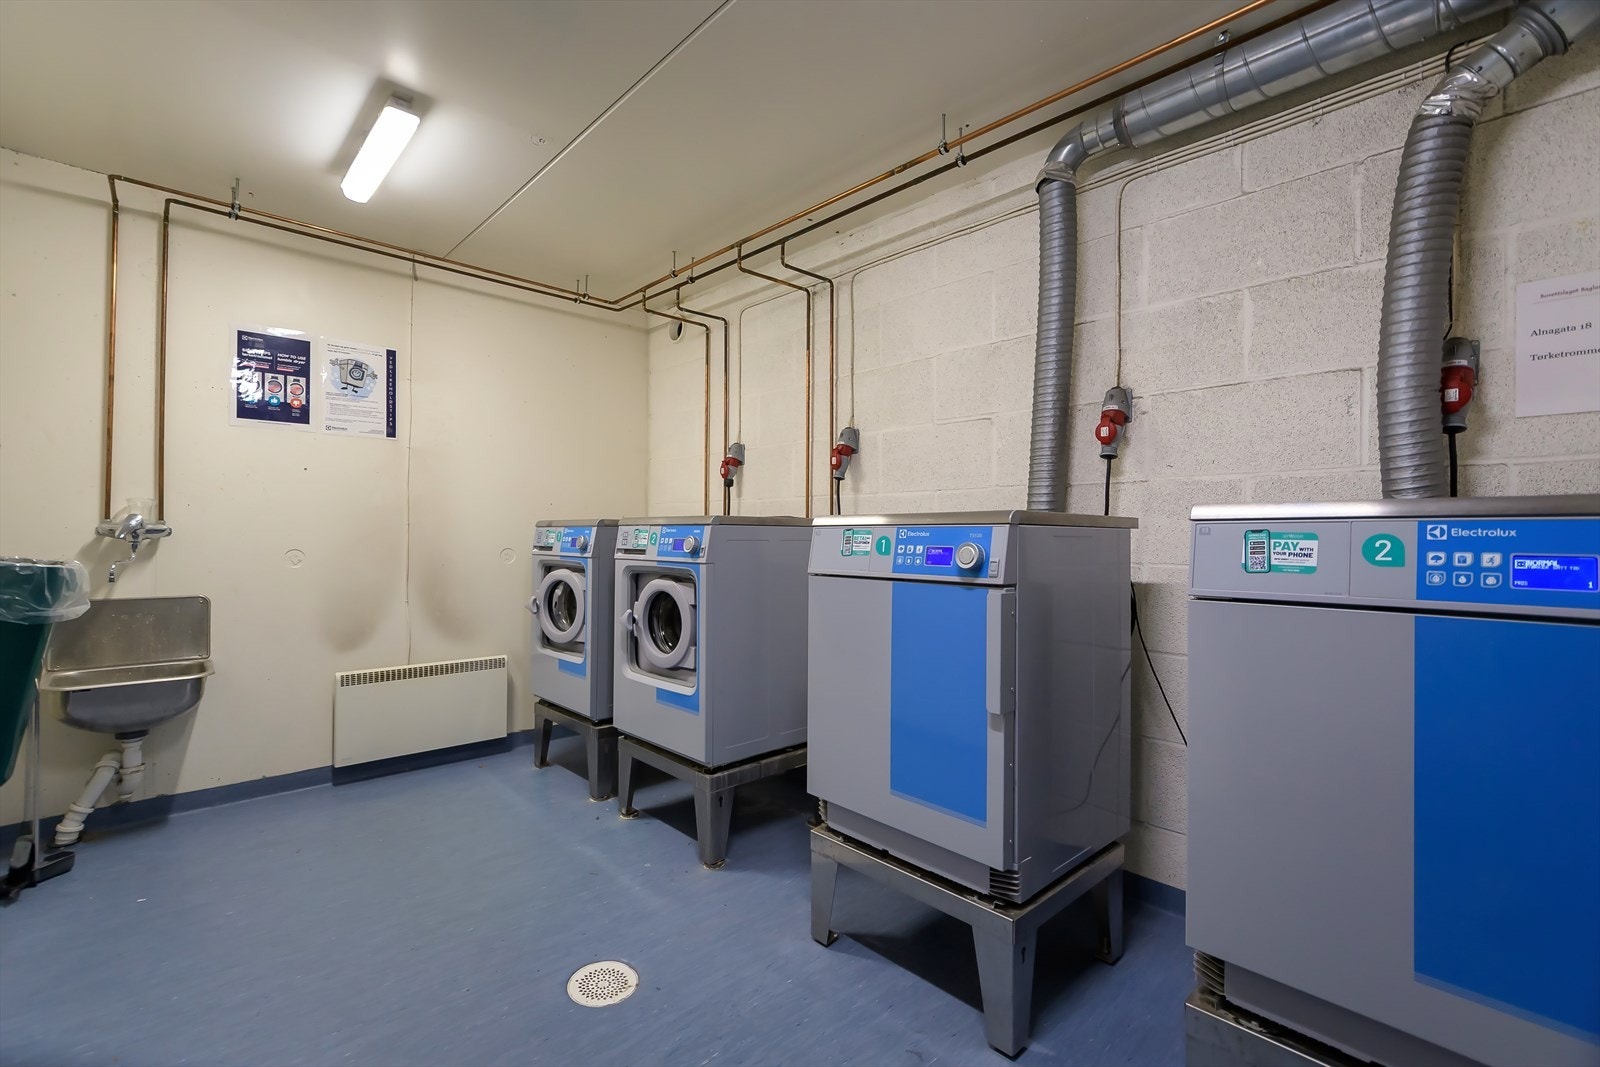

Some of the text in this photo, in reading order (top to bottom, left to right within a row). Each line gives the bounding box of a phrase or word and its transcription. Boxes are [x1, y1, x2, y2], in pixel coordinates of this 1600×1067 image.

[1530, 321, 1592, 337] Alnagata 18
[1451, 528, 1517, 538] Electrolux
[650, 534, 656, 544] 2
[881, 539, 886, 553] 1
[1272, 541, 1300, 551] PAY
[1375, 540, 1392, 561] 2
[1588, 581, 1594, 589] 1
